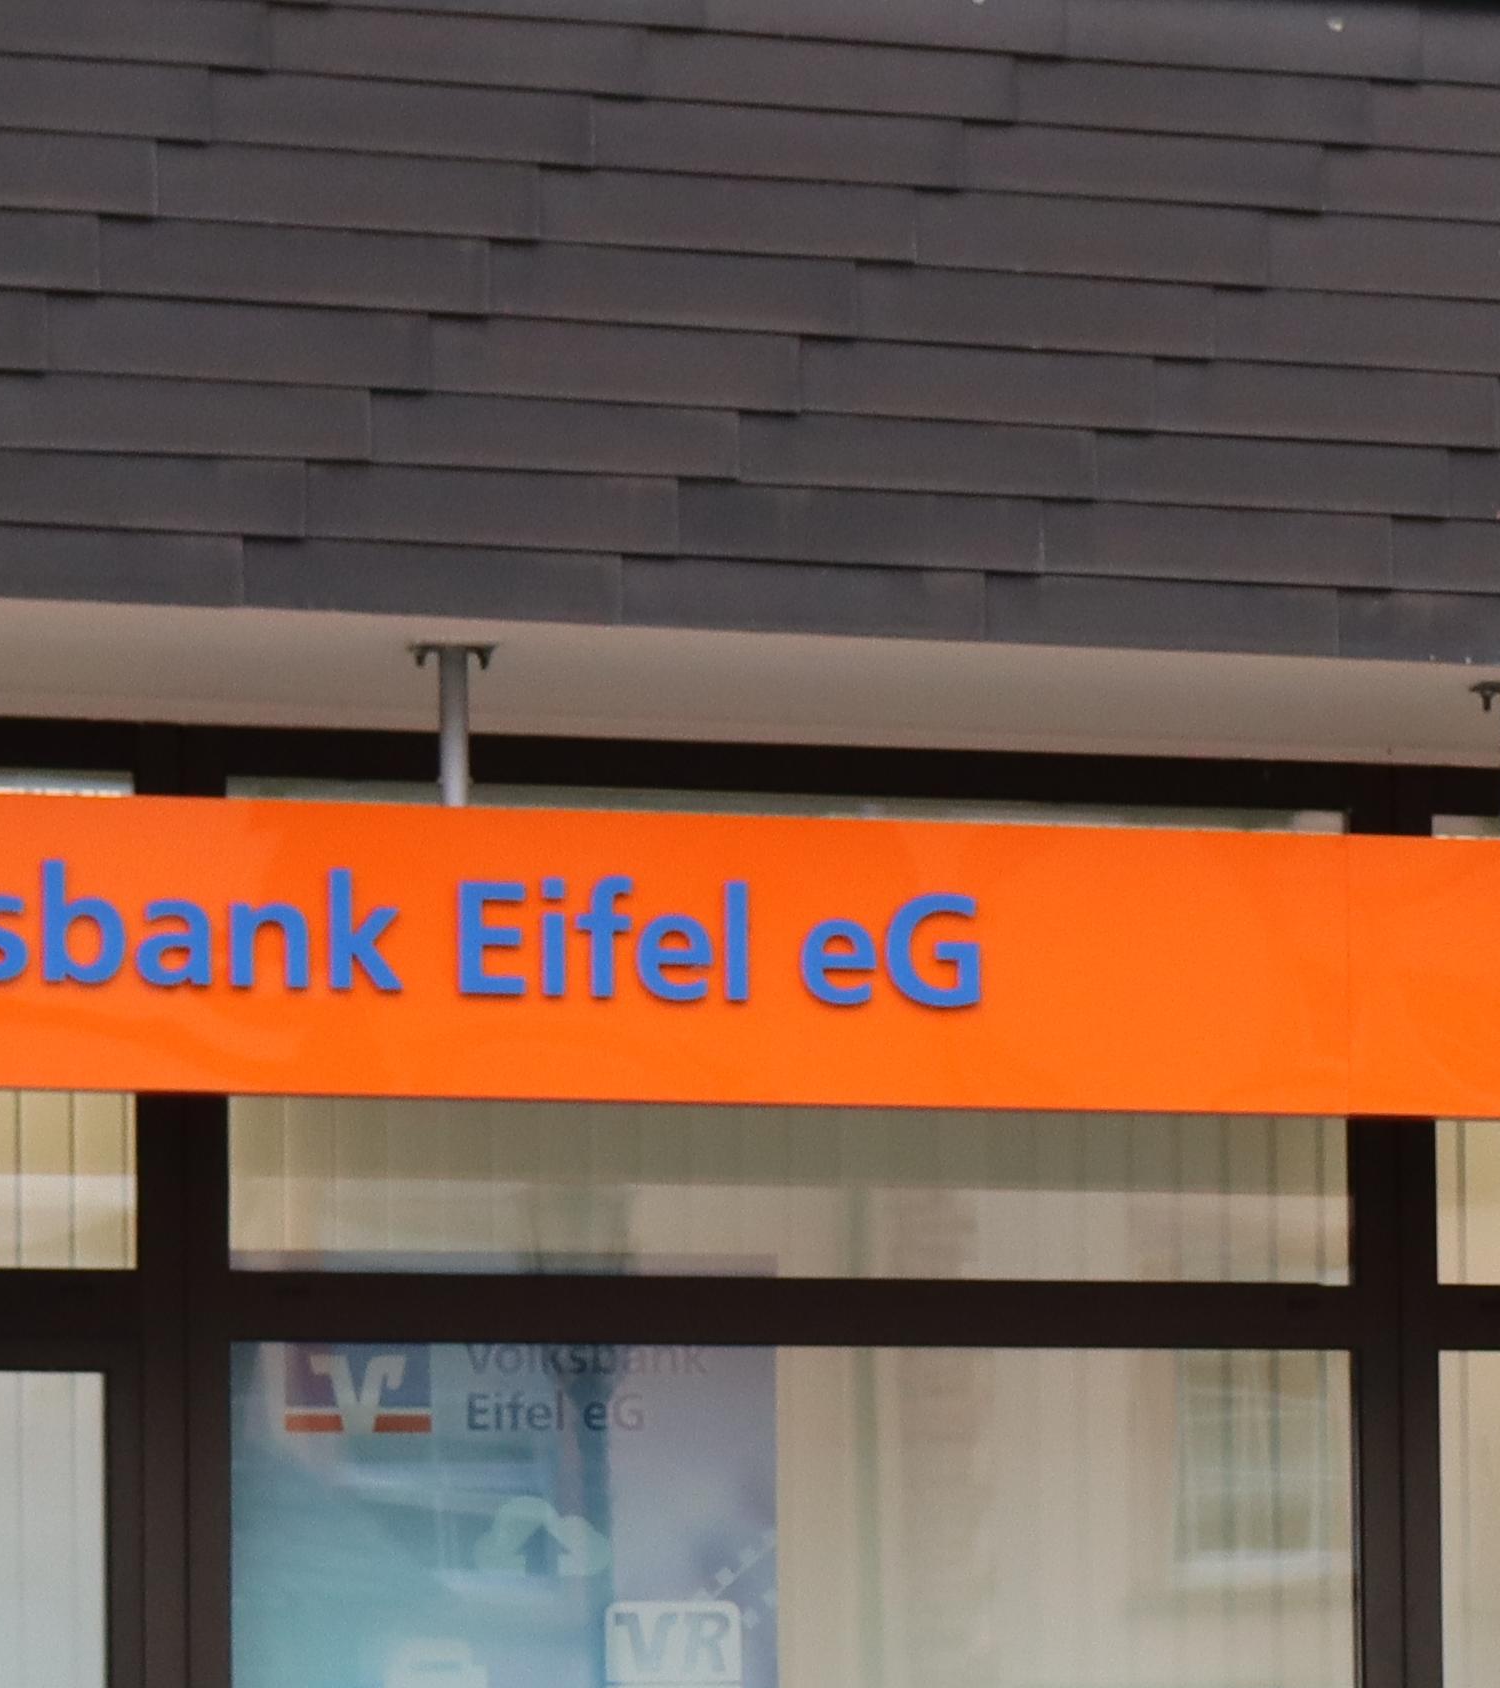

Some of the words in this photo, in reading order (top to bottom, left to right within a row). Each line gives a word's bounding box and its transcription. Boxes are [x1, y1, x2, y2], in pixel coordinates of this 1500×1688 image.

[456, 875, 750, 1004] Eifel
[800, 892, 983, 1009] eG
[466, 1344, 708, 1375] Volksbank
[467, 1389, 564, 1431] Eifel
[583, 1393, 645, 1431] eG
[613, 1610, 733, 1679] VR
